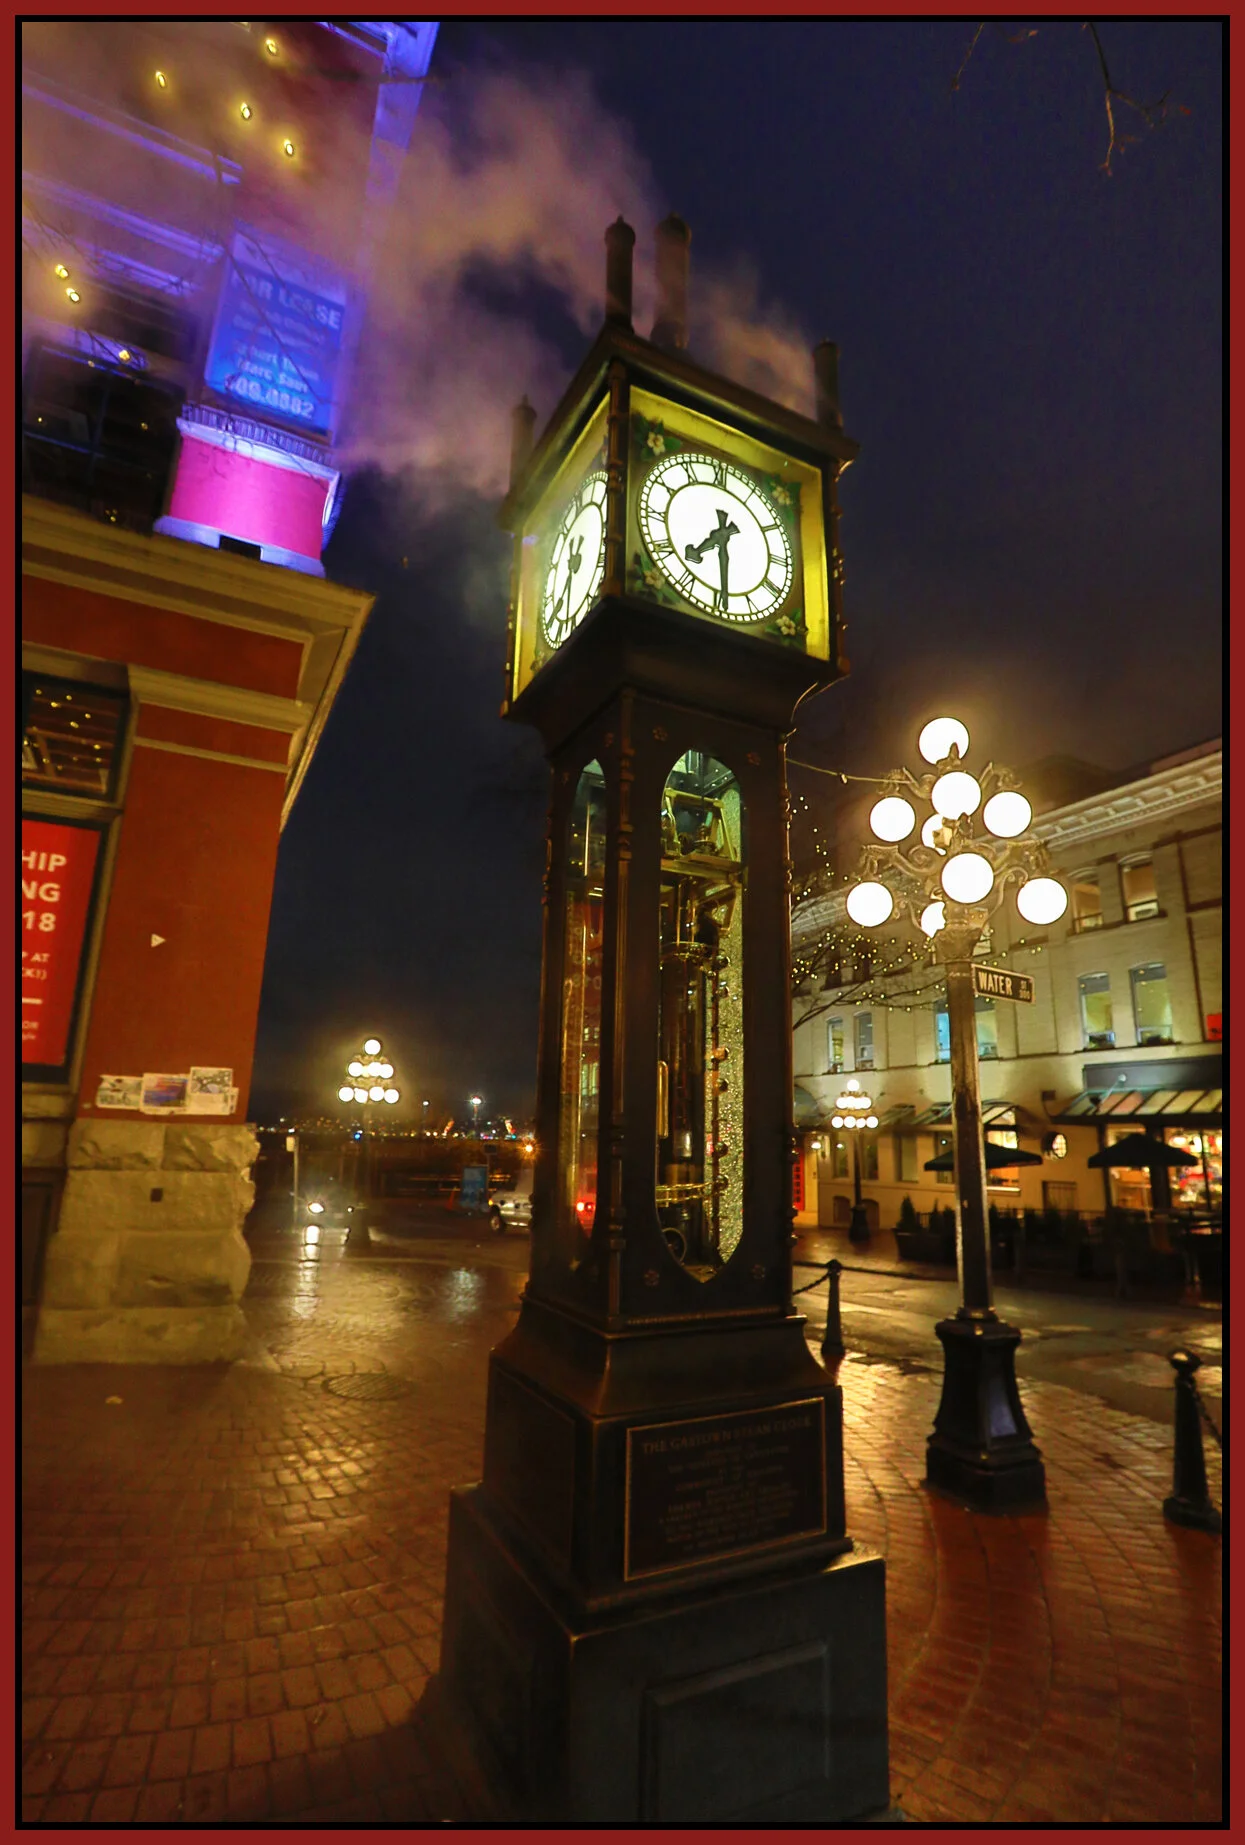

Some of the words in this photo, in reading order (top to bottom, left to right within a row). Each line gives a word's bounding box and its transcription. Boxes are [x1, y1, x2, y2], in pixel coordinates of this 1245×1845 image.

[278, 287, 342, 330] LEASE
[22, 909, 56, 933] 18
[978, 971, 1012, 996] WATER
[643, 1440, 669, 1455] THE
